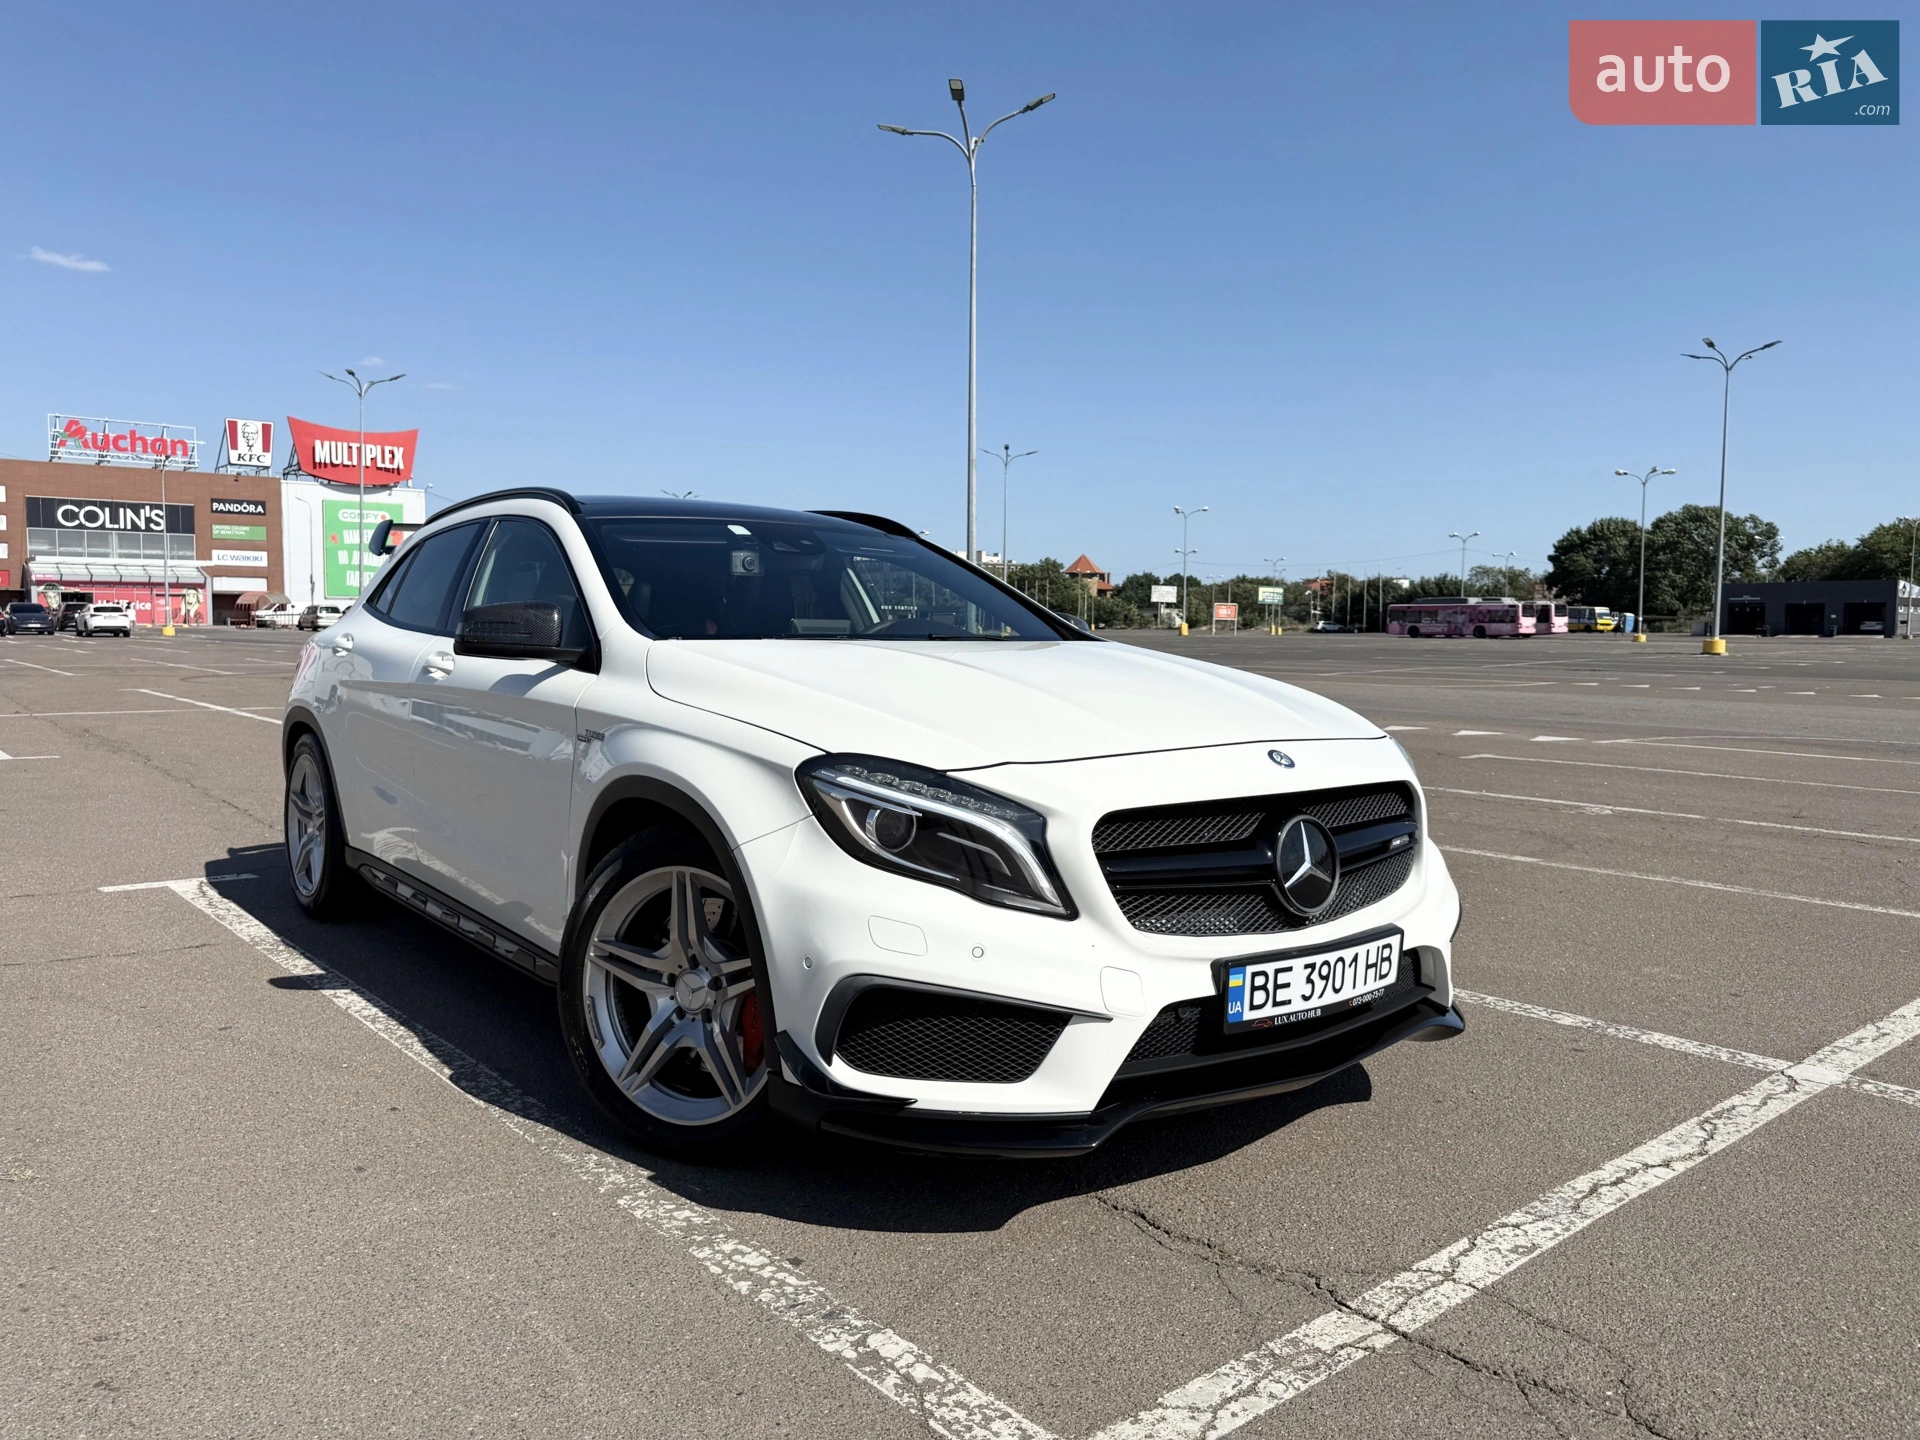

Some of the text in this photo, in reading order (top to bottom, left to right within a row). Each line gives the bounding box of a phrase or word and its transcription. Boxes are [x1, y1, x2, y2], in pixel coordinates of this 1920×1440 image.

[57, 418, 189, 457] Auchan
[236, 453, 266, 464] KFC
[314, 439, 405, 470] MULTIPLEX
[57, 504, 165, 531] COLIN'S
[212, 502, 264, 513] PANDORA
[1249, 942, 1394, 1012] BE 3901 HB
[1228, 1001, 1242, 1014] UA
[1274, 1008, 1322, 1025] LUX AUTO HUB
